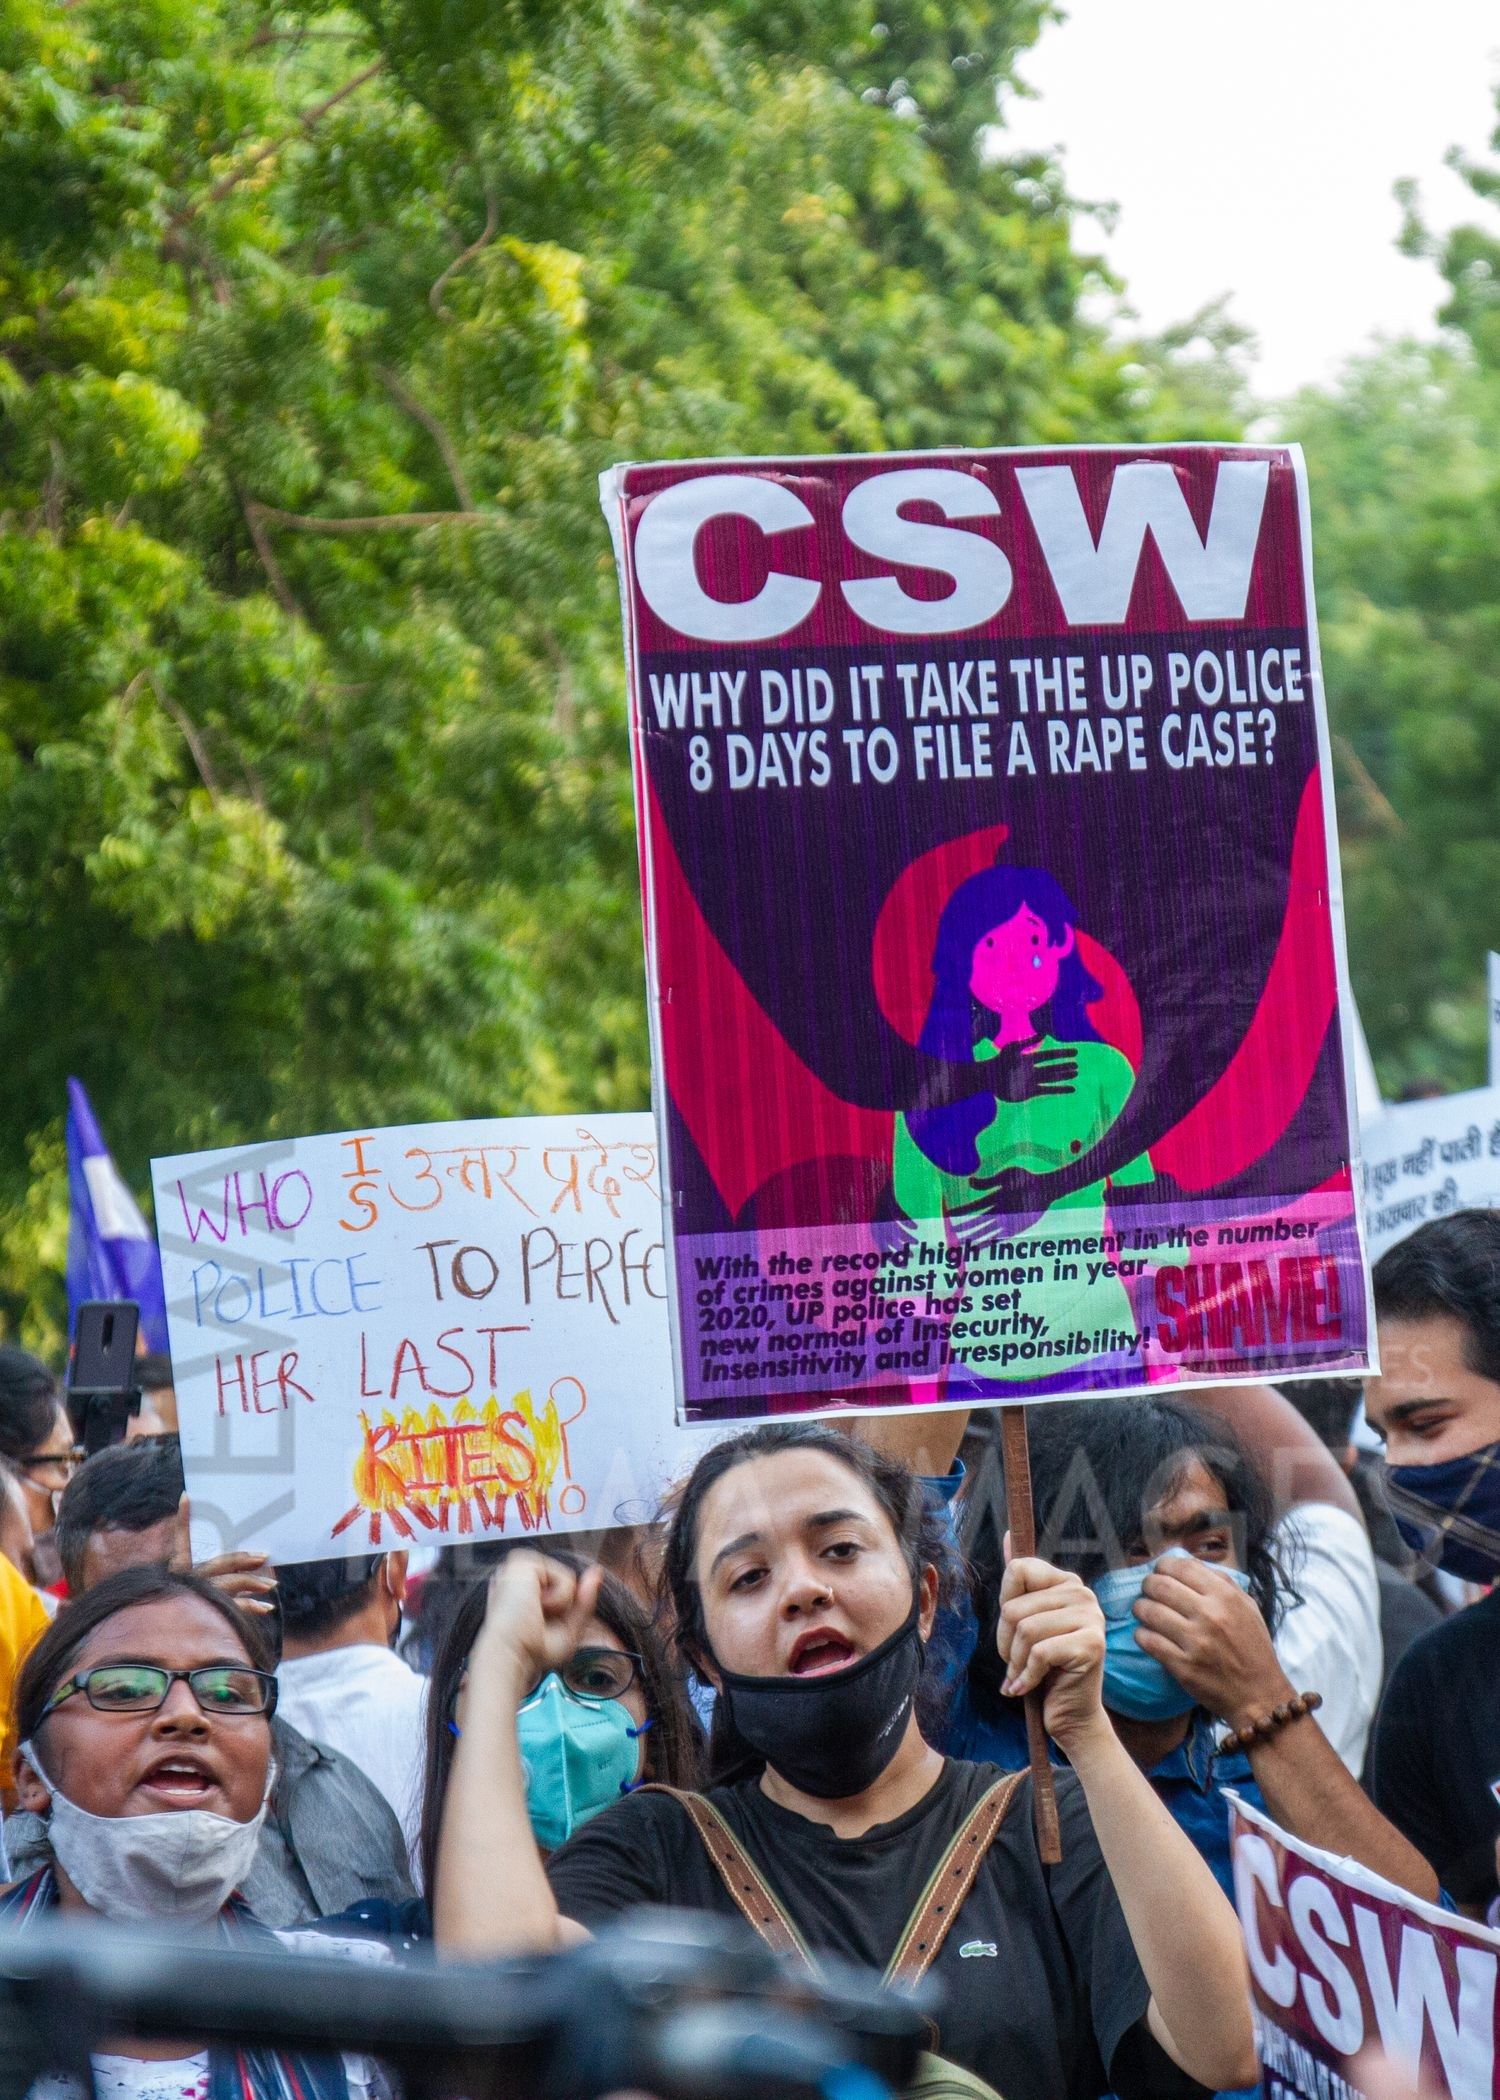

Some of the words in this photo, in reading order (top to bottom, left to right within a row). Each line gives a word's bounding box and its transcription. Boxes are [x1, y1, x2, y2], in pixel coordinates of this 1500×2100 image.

[633, 460, 1270, 642] CSW
[648, 671, 747, 729] WHY
[760, 667, 834, 725] DID
[849, 664, 884, 721] IT
[896, 660, 999, 719] TAKE
[1009, 656, 1088, 713] THE
[1100, 653, 1154, 710] UP
[1168, 648, 1305, 707] POLICE
[689, 735, 713, 792] 8
[726, 729, 831, 790] DAYS
[842, 726, 898, 784] TO
[913, 722, 993, 781] FILE
[1007, 720, 1036, 776] A
[1047, 716, 1148, 774] RAPE
[1161, 708, 1277, 770] CASE?
[177, 1168, 313, 1244] WHO
[191, 1252, 382, 1328] POLICE
[412, 1239, 500, 1301] TO
[694, 1253, 760, 1281] With
[767, 1251, 813, 1276] the
[821, 1242, 911, 1273] record
[918, 1238, 980, 1270] high
[1134, 1228, 1159, 1250] in
[1167, 1223, 1209, 1249] the
[1217, 1217, 1320, 1246] number
[696, 1281, 727, 1307] of
[733, 1279, 824, 1305] crimes
[831, 1270, 937, 1302] against
[943, 1264, 1044, 1289] women
[1053, 1259, 1078, 1282] in
[1086, 1258, 1149, 1285] year
[699, 1304, 777, 1332] 2020,
[785, 1301, 825, 1326] UP
[832, 1295, 916, 1329] police
[925, 1292, 974, 1316] has
[981, 1288, 1022, 1312] set
[701, 1336, 760, 1357] new
[767, 1322, 867, 1351] normal
[874, 1318, 905, 1345] of
[912, 1311, 1051, 1342] Insecurity,
[1155, 1254, 1343, 1354] SHAME!
[215, 1349, 315, 1417] HER
[359, 1325, 531, 1400] LAST
[702, 1350, 867, 1383] Insensitivity
[874, 1342, 931, 1370] and
[940, 1326, 1151, 1367] Irresponsibility!
[1234, 1833, 1498, 2100] CSW
